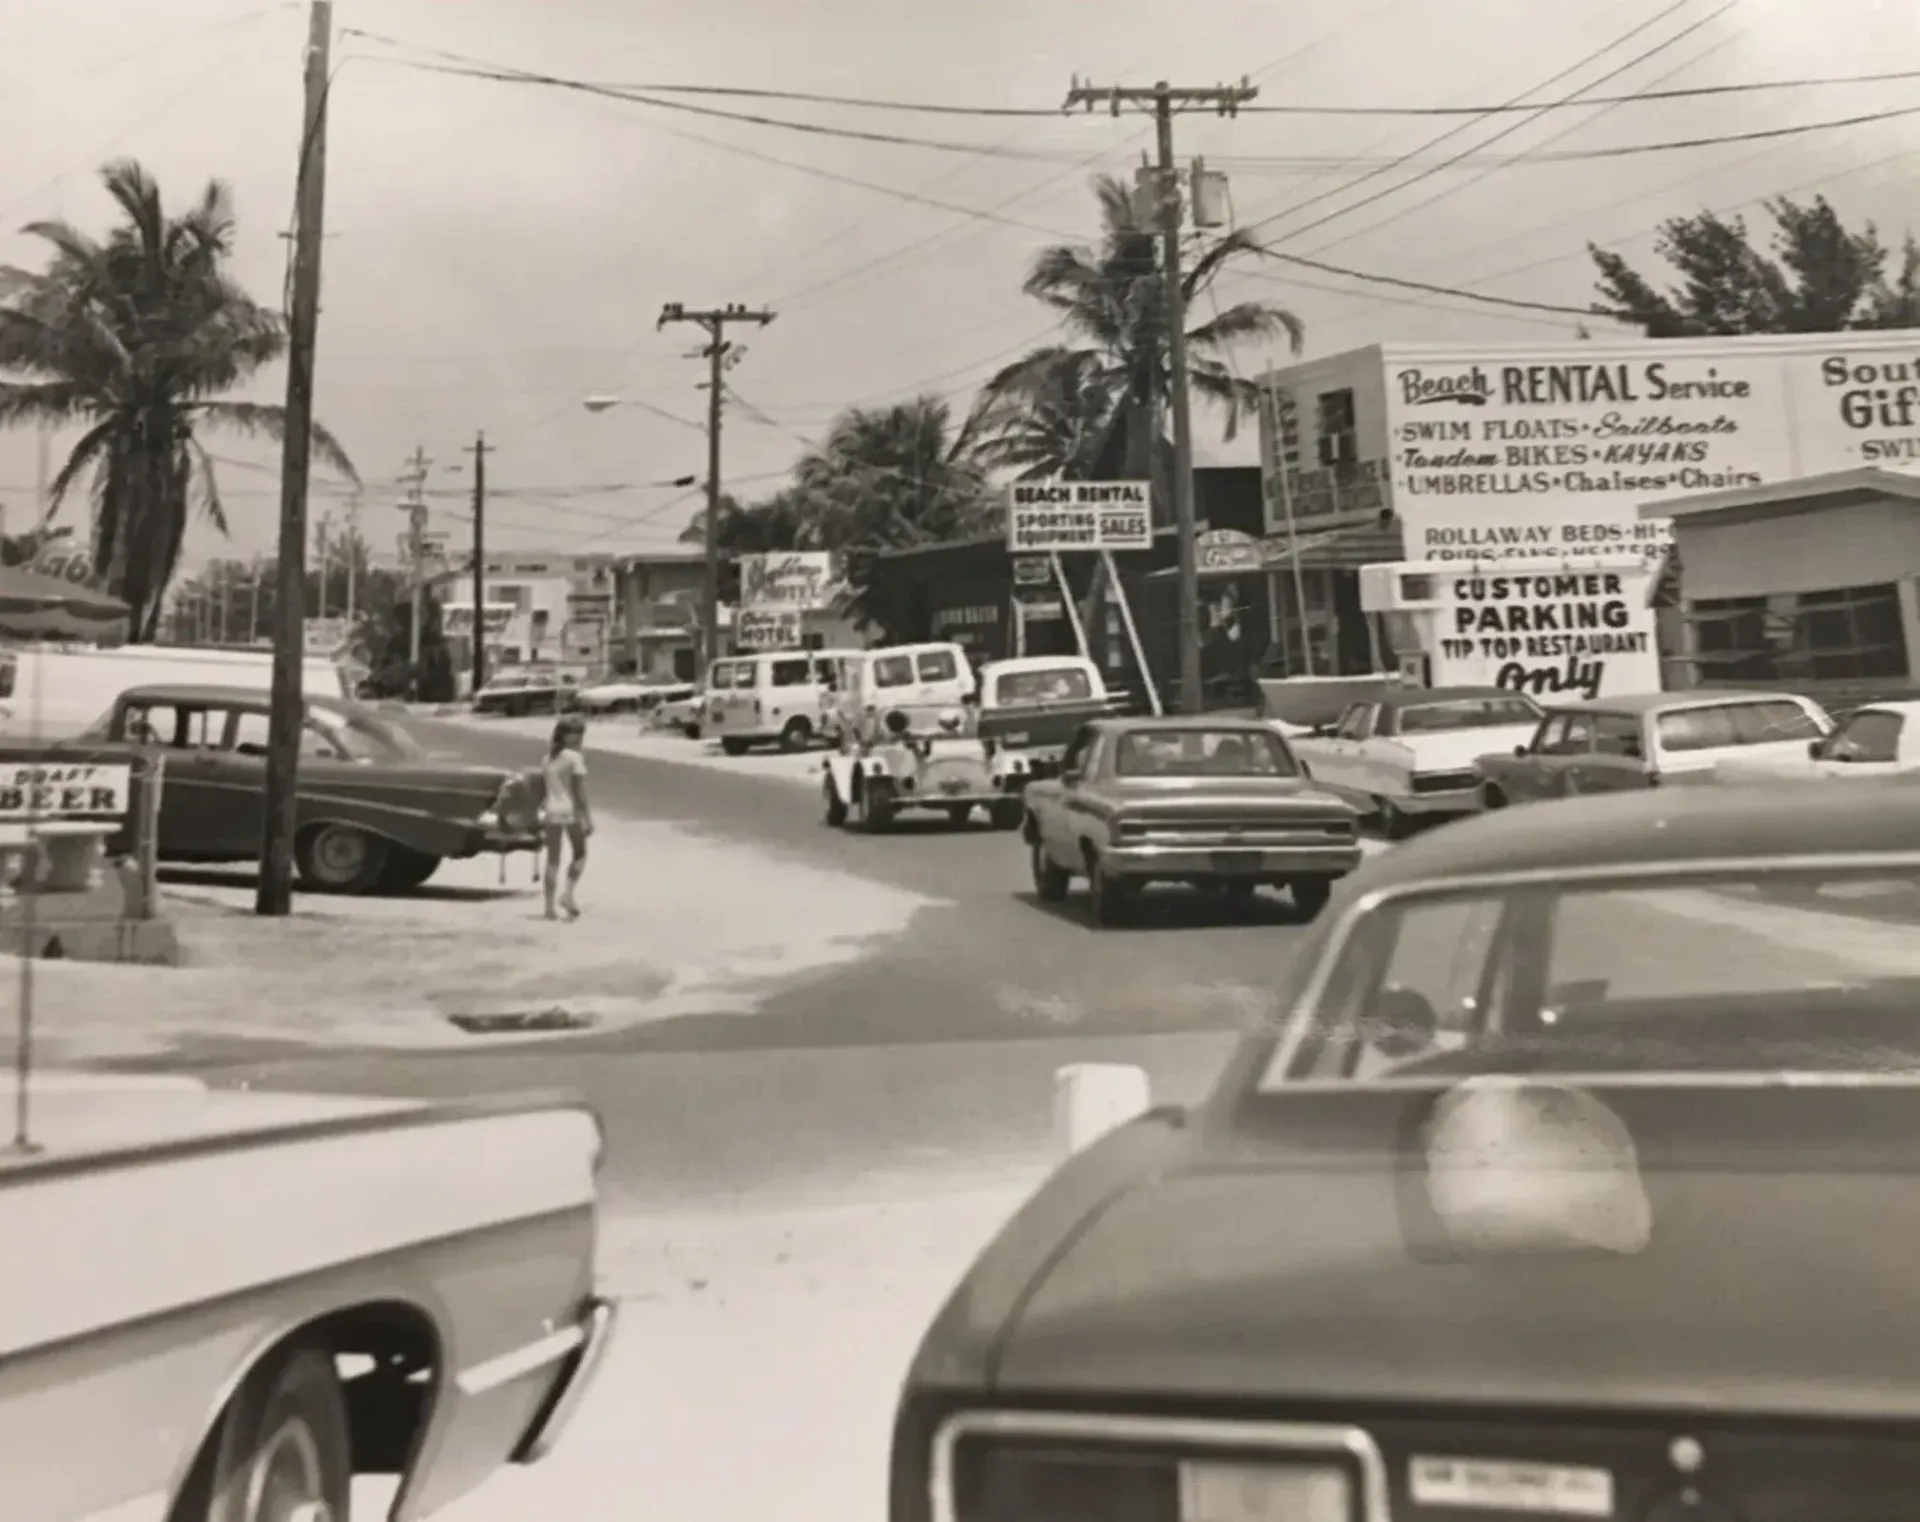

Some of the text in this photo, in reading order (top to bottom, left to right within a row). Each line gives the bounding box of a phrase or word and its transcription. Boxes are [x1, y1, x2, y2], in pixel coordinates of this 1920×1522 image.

[1398, 362, 1750, 405] Beach RENTAL Service
[1840, 385, 1920, 428] Gif
[1401, 411, 1739, 442] SWIM FLOATS Sailboats
[1403, 440, 1709, 468] Tandem BIKES KAYAKS
[1861, 437, 1920, 460] SWI
[1407, 465, 1761, 495] UMBRELLAS Chaises Chairs
[1015, 486, 1144, 503] BEACH RENTAL
[1016, 512, 1095, 528] SPORTING
[1100, 517, 1147, 535] SALES
[1425, 525, 1552, 546] ROLLAWAY
[1561, 523, 1622, 543] BEDS
[1454, 574, 1622, 601] CUSTOMER
[1456, 600, 1630, 633] PARKING
[1441, 632, 1648, 660] TIP TOP RESTAURANT
[1496, 656, 1605, 701] Only
[0, 786, 115, 810] BEER
